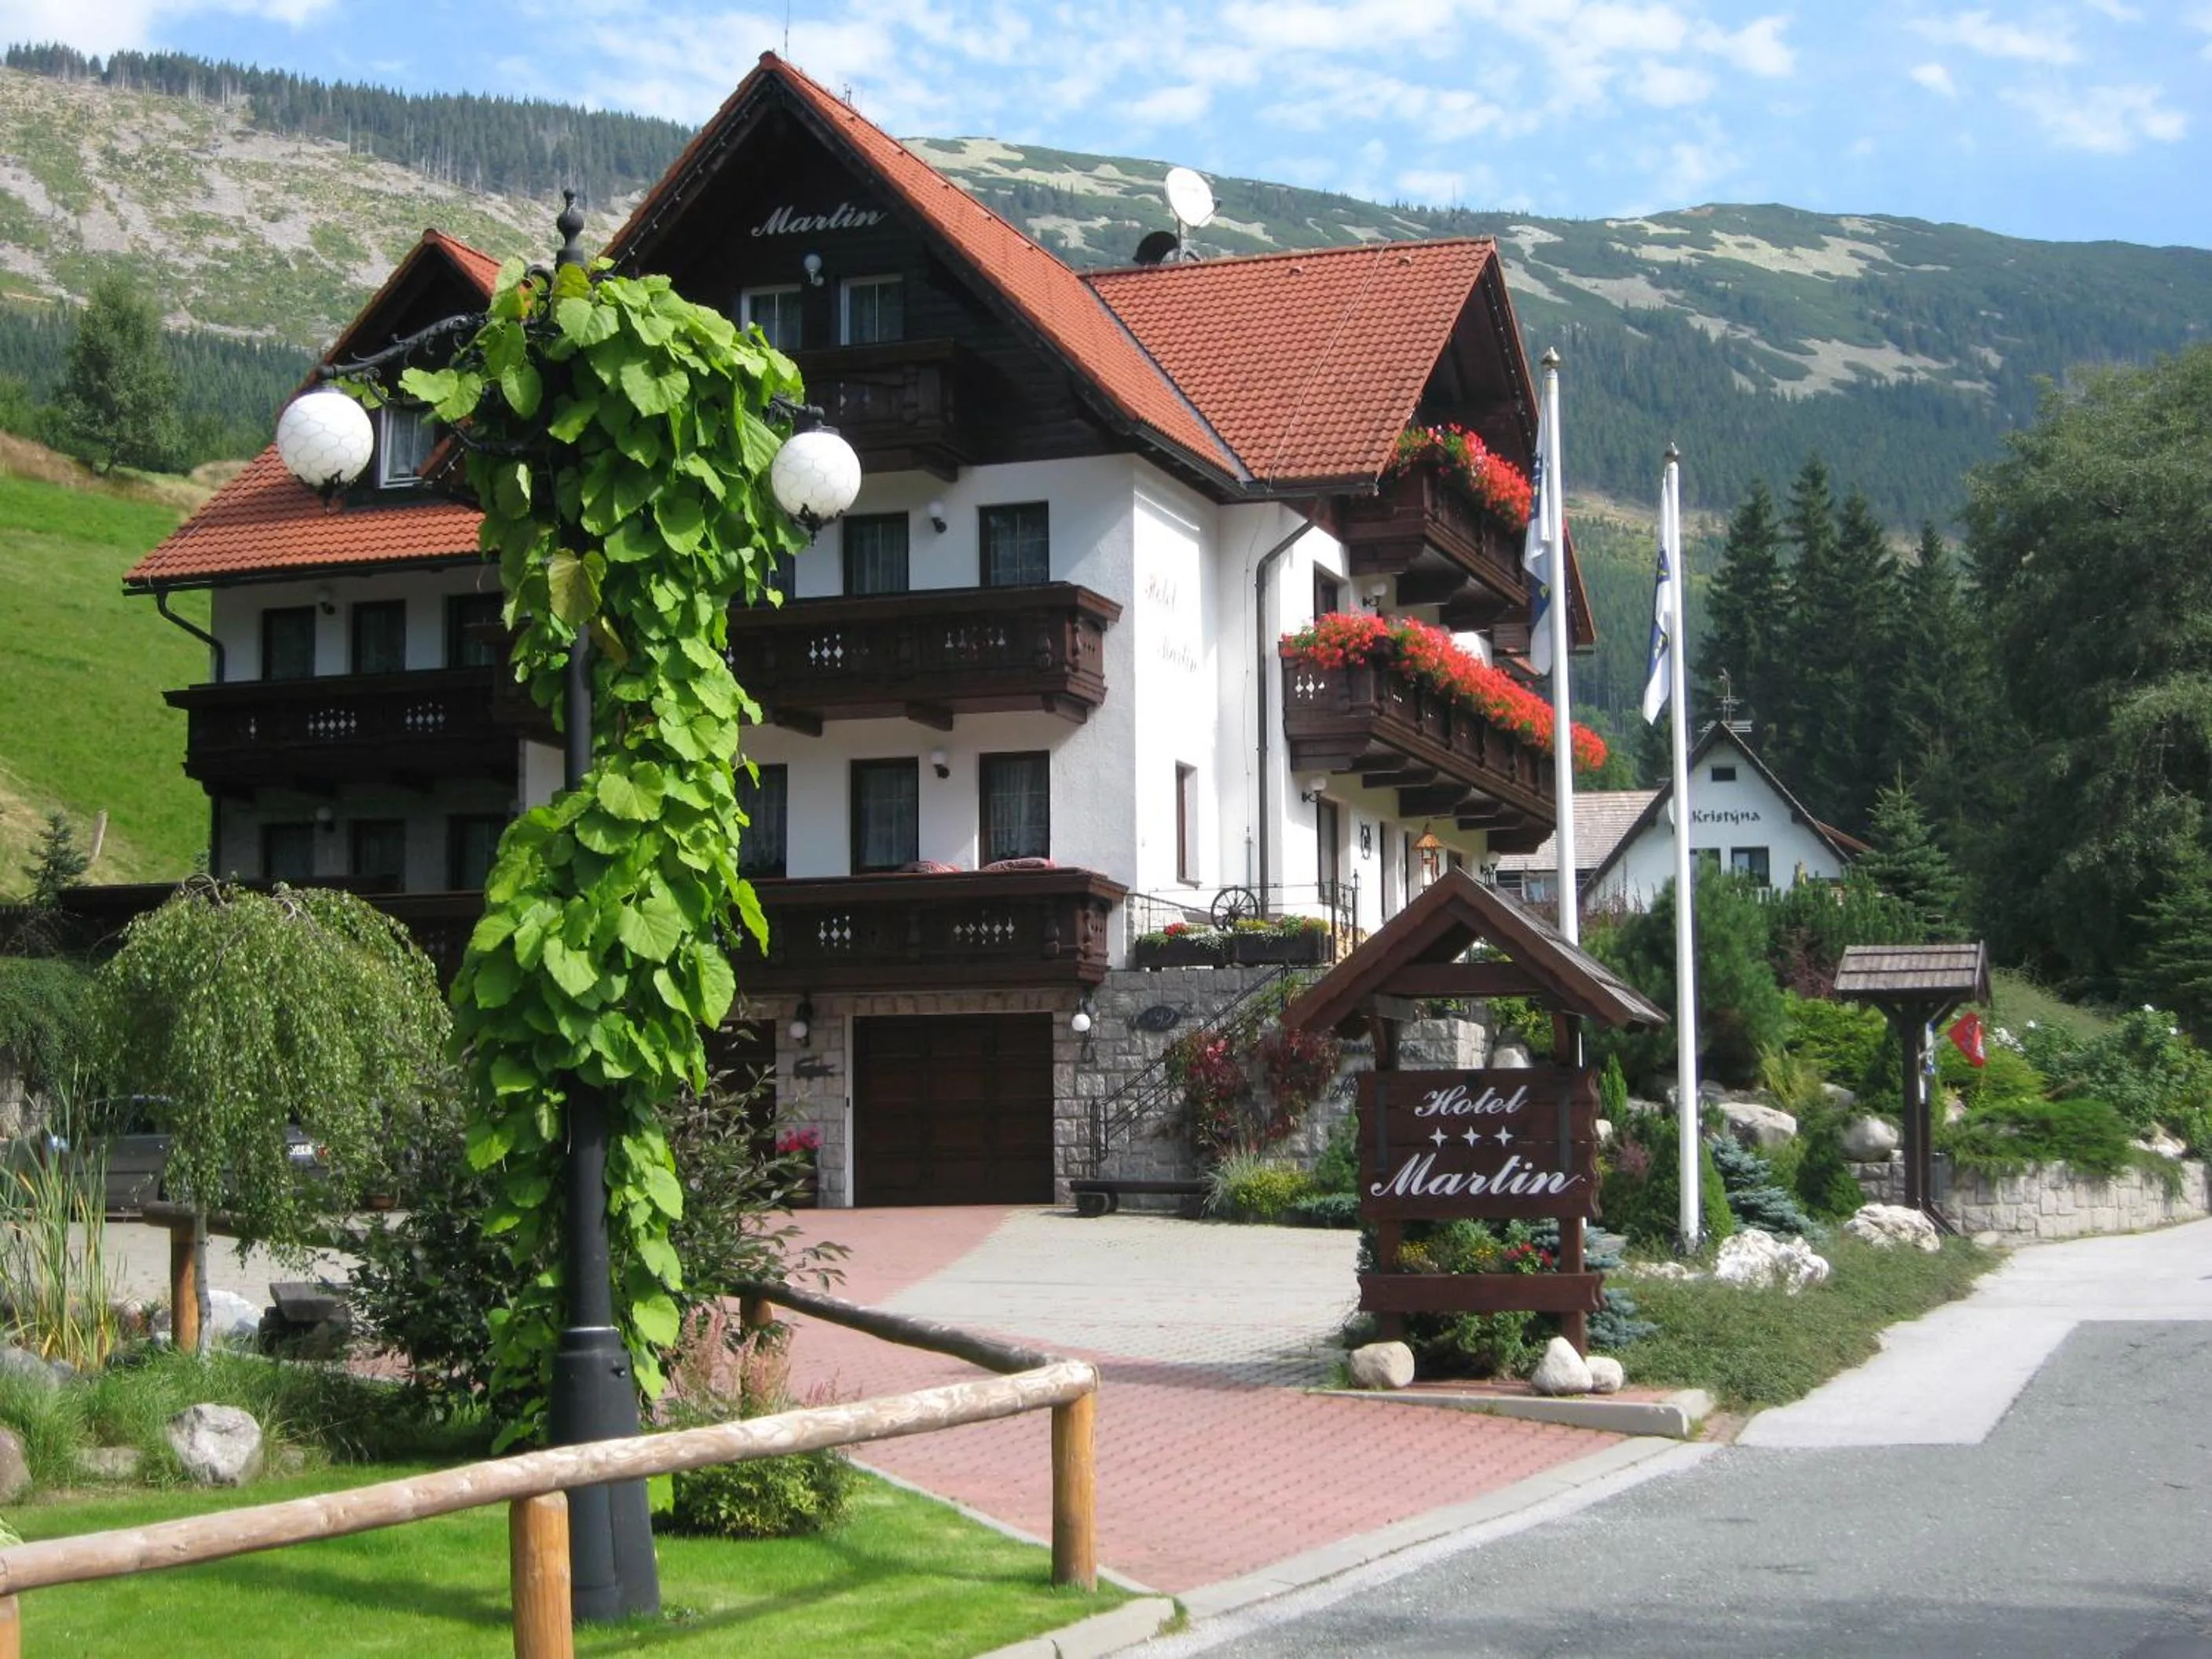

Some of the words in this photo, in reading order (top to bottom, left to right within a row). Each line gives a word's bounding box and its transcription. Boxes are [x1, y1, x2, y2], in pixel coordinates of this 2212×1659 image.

[750, 202, 888, 236] Martin
[1415, 1084, 1528, 1117] Hotel
[1370, 1152, 1585, 1196] Martin
